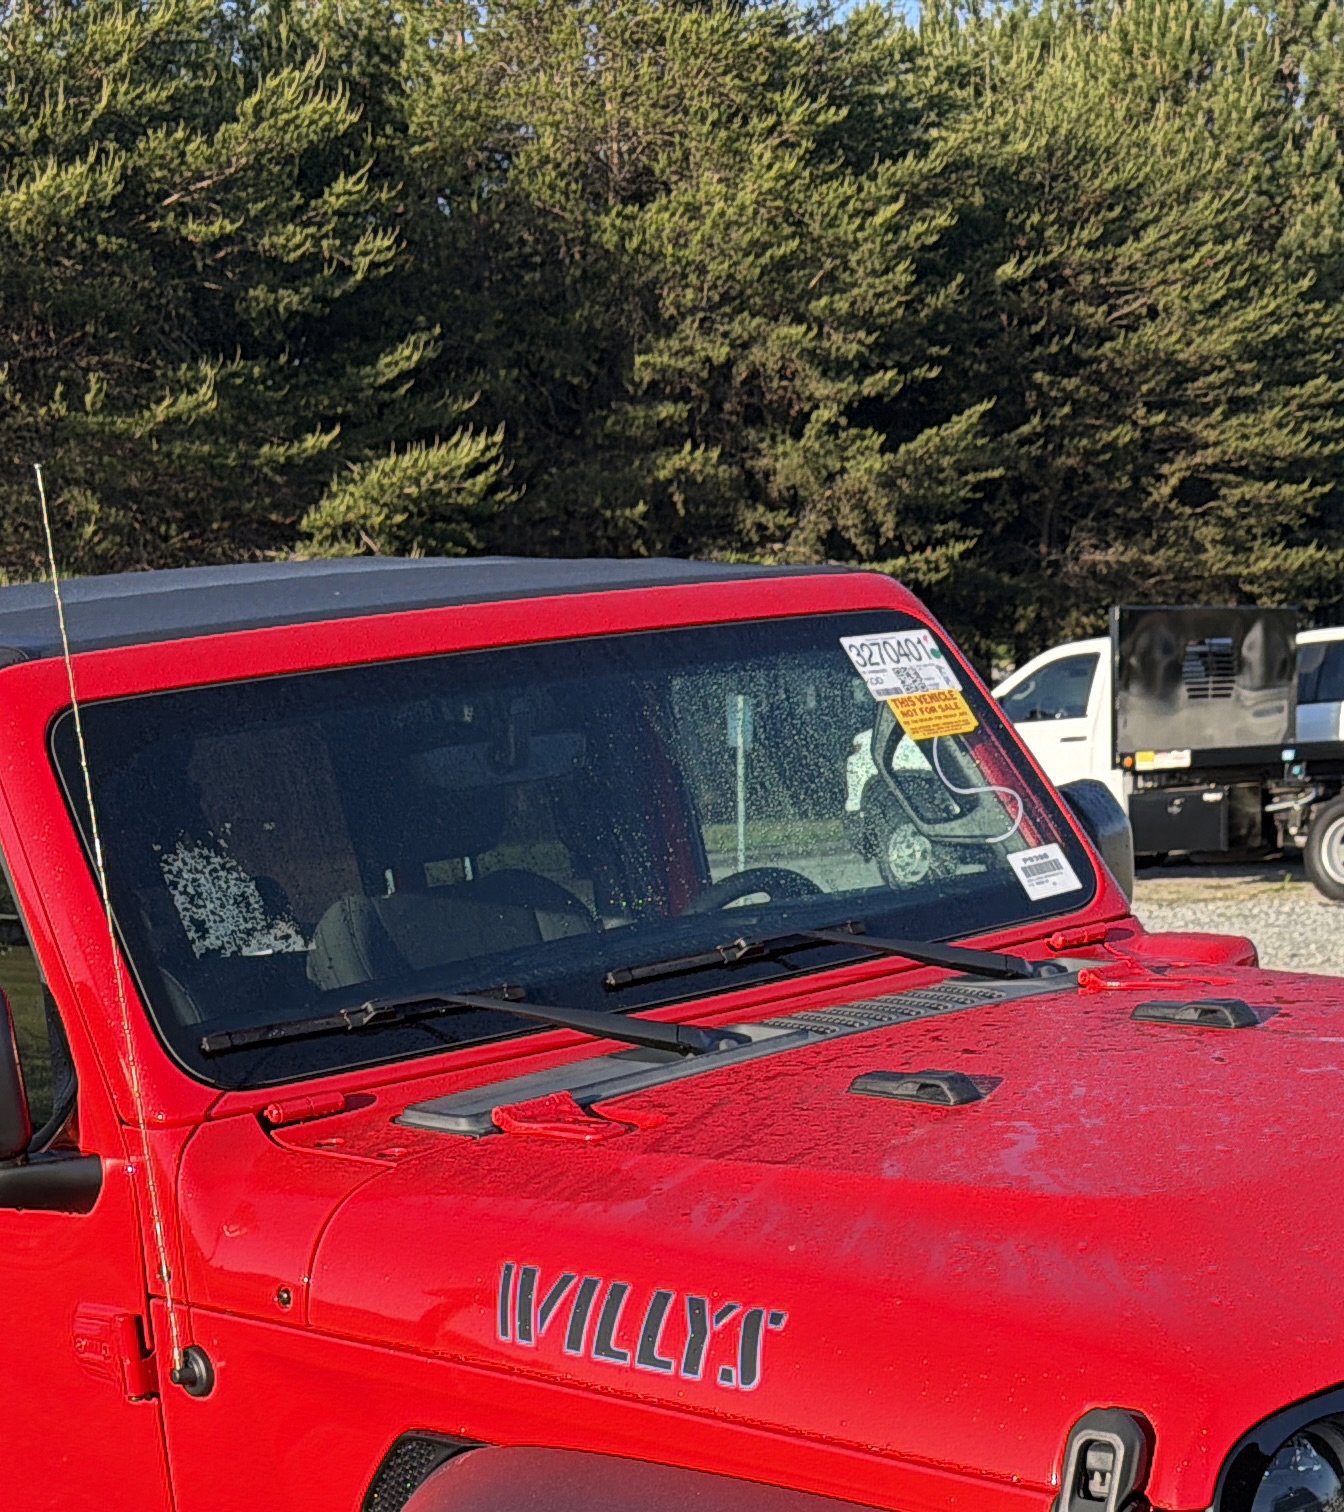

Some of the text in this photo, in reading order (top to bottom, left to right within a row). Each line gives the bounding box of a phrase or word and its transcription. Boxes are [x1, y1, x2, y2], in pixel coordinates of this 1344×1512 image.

[849, 638, 932, 667] 3270401
[891, 695, 917, 709] THIS
[915, 689, 958, 705] VEHICLE
[900, 701, 962, 718] NOT FOR SALE
[497, 1261, 788, 1391] WILLYS
